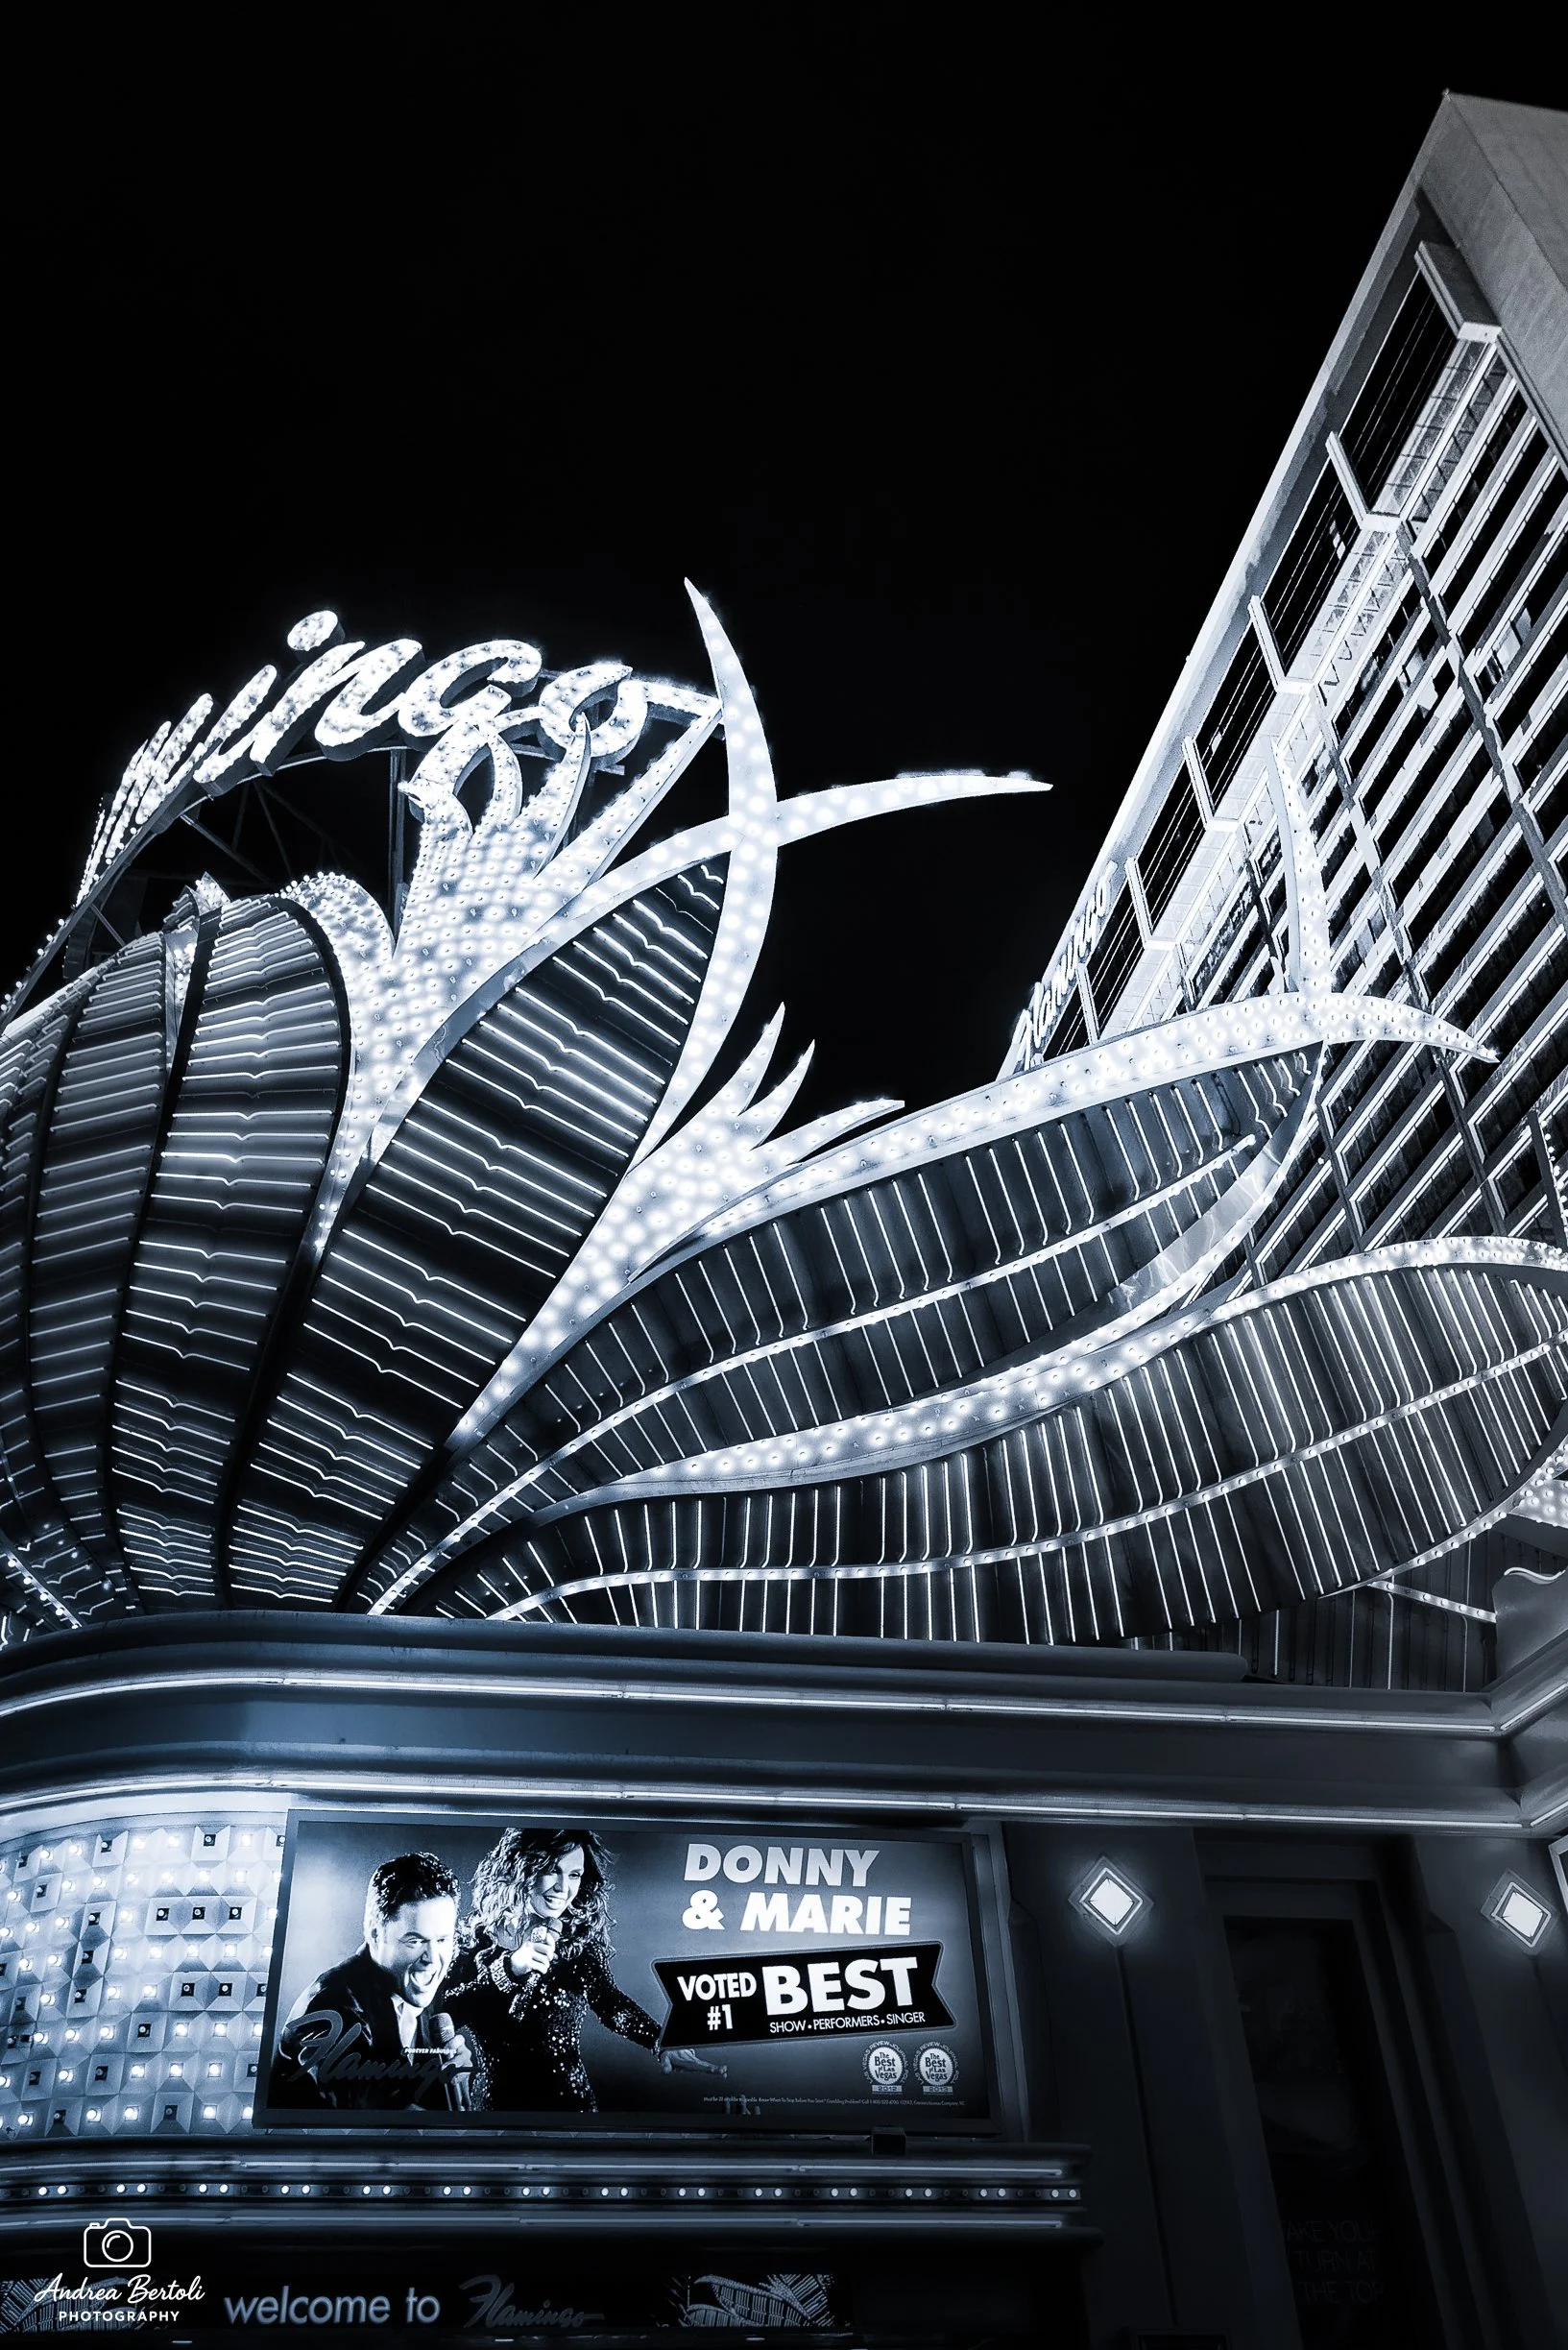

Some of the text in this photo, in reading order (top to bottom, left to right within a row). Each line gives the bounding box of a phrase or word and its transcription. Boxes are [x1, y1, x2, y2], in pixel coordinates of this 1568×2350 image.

[683, 1843, 880, 1887] DONNY
[682, 1889, 912, 1936] & MARIE
[677, 1972, 758, 2001] VOTED
[761, 1957, 918, 2016] BEST
[707, 2003, 734, 2031] #1
[769, 2011, 927, 2033] SHOW PERFORMERS SINGER
[286, 2009, 485, 2103] Flamingo
[875, 2056, 896, 2067] Best
[925, 2057, 947, 2068] Best
[875, 2070, 898, 2081] Vegas
[926, 2071, 948, 2082] Vegas
[224, 2273, 606, 2328] welcome to Flamingo
